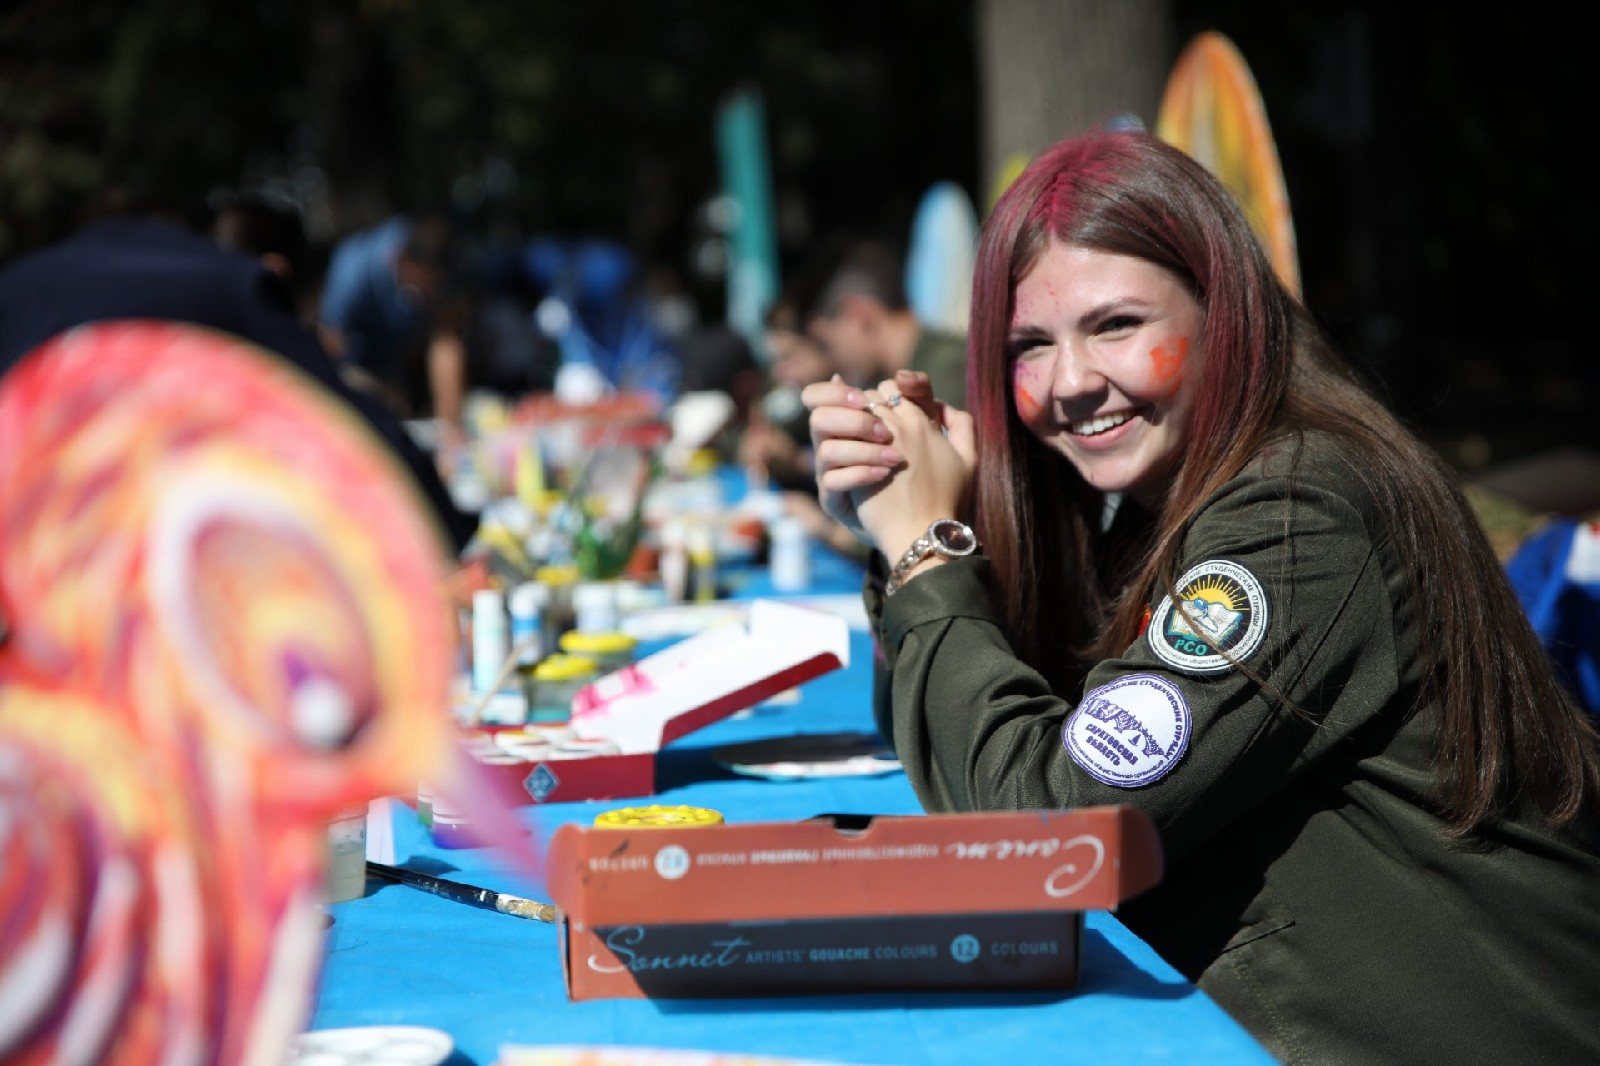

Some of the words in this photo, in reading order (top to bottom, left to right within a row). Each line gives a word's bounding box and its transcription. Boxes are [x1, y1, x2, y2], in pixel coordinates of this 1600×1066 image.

[1173, 638, 1208, 656] РСО
[1139, 679, 1184, 723] СТУДЕНЧЕСКИЕ
[1165, 724, 1183, 761] ОТРЯДЫ
[1085, 723, 1139, 766] САРАТОВСКАЯ
[1085, 735, 1121, 767] ОБЛАСТЬ
[588, 925, 752, 974] Sonnet
[809, 947, 870, 961] GOUACHE
[874, 943, 939, 960] COLOURS
[990, 940, 1059, 957] COLOURS
